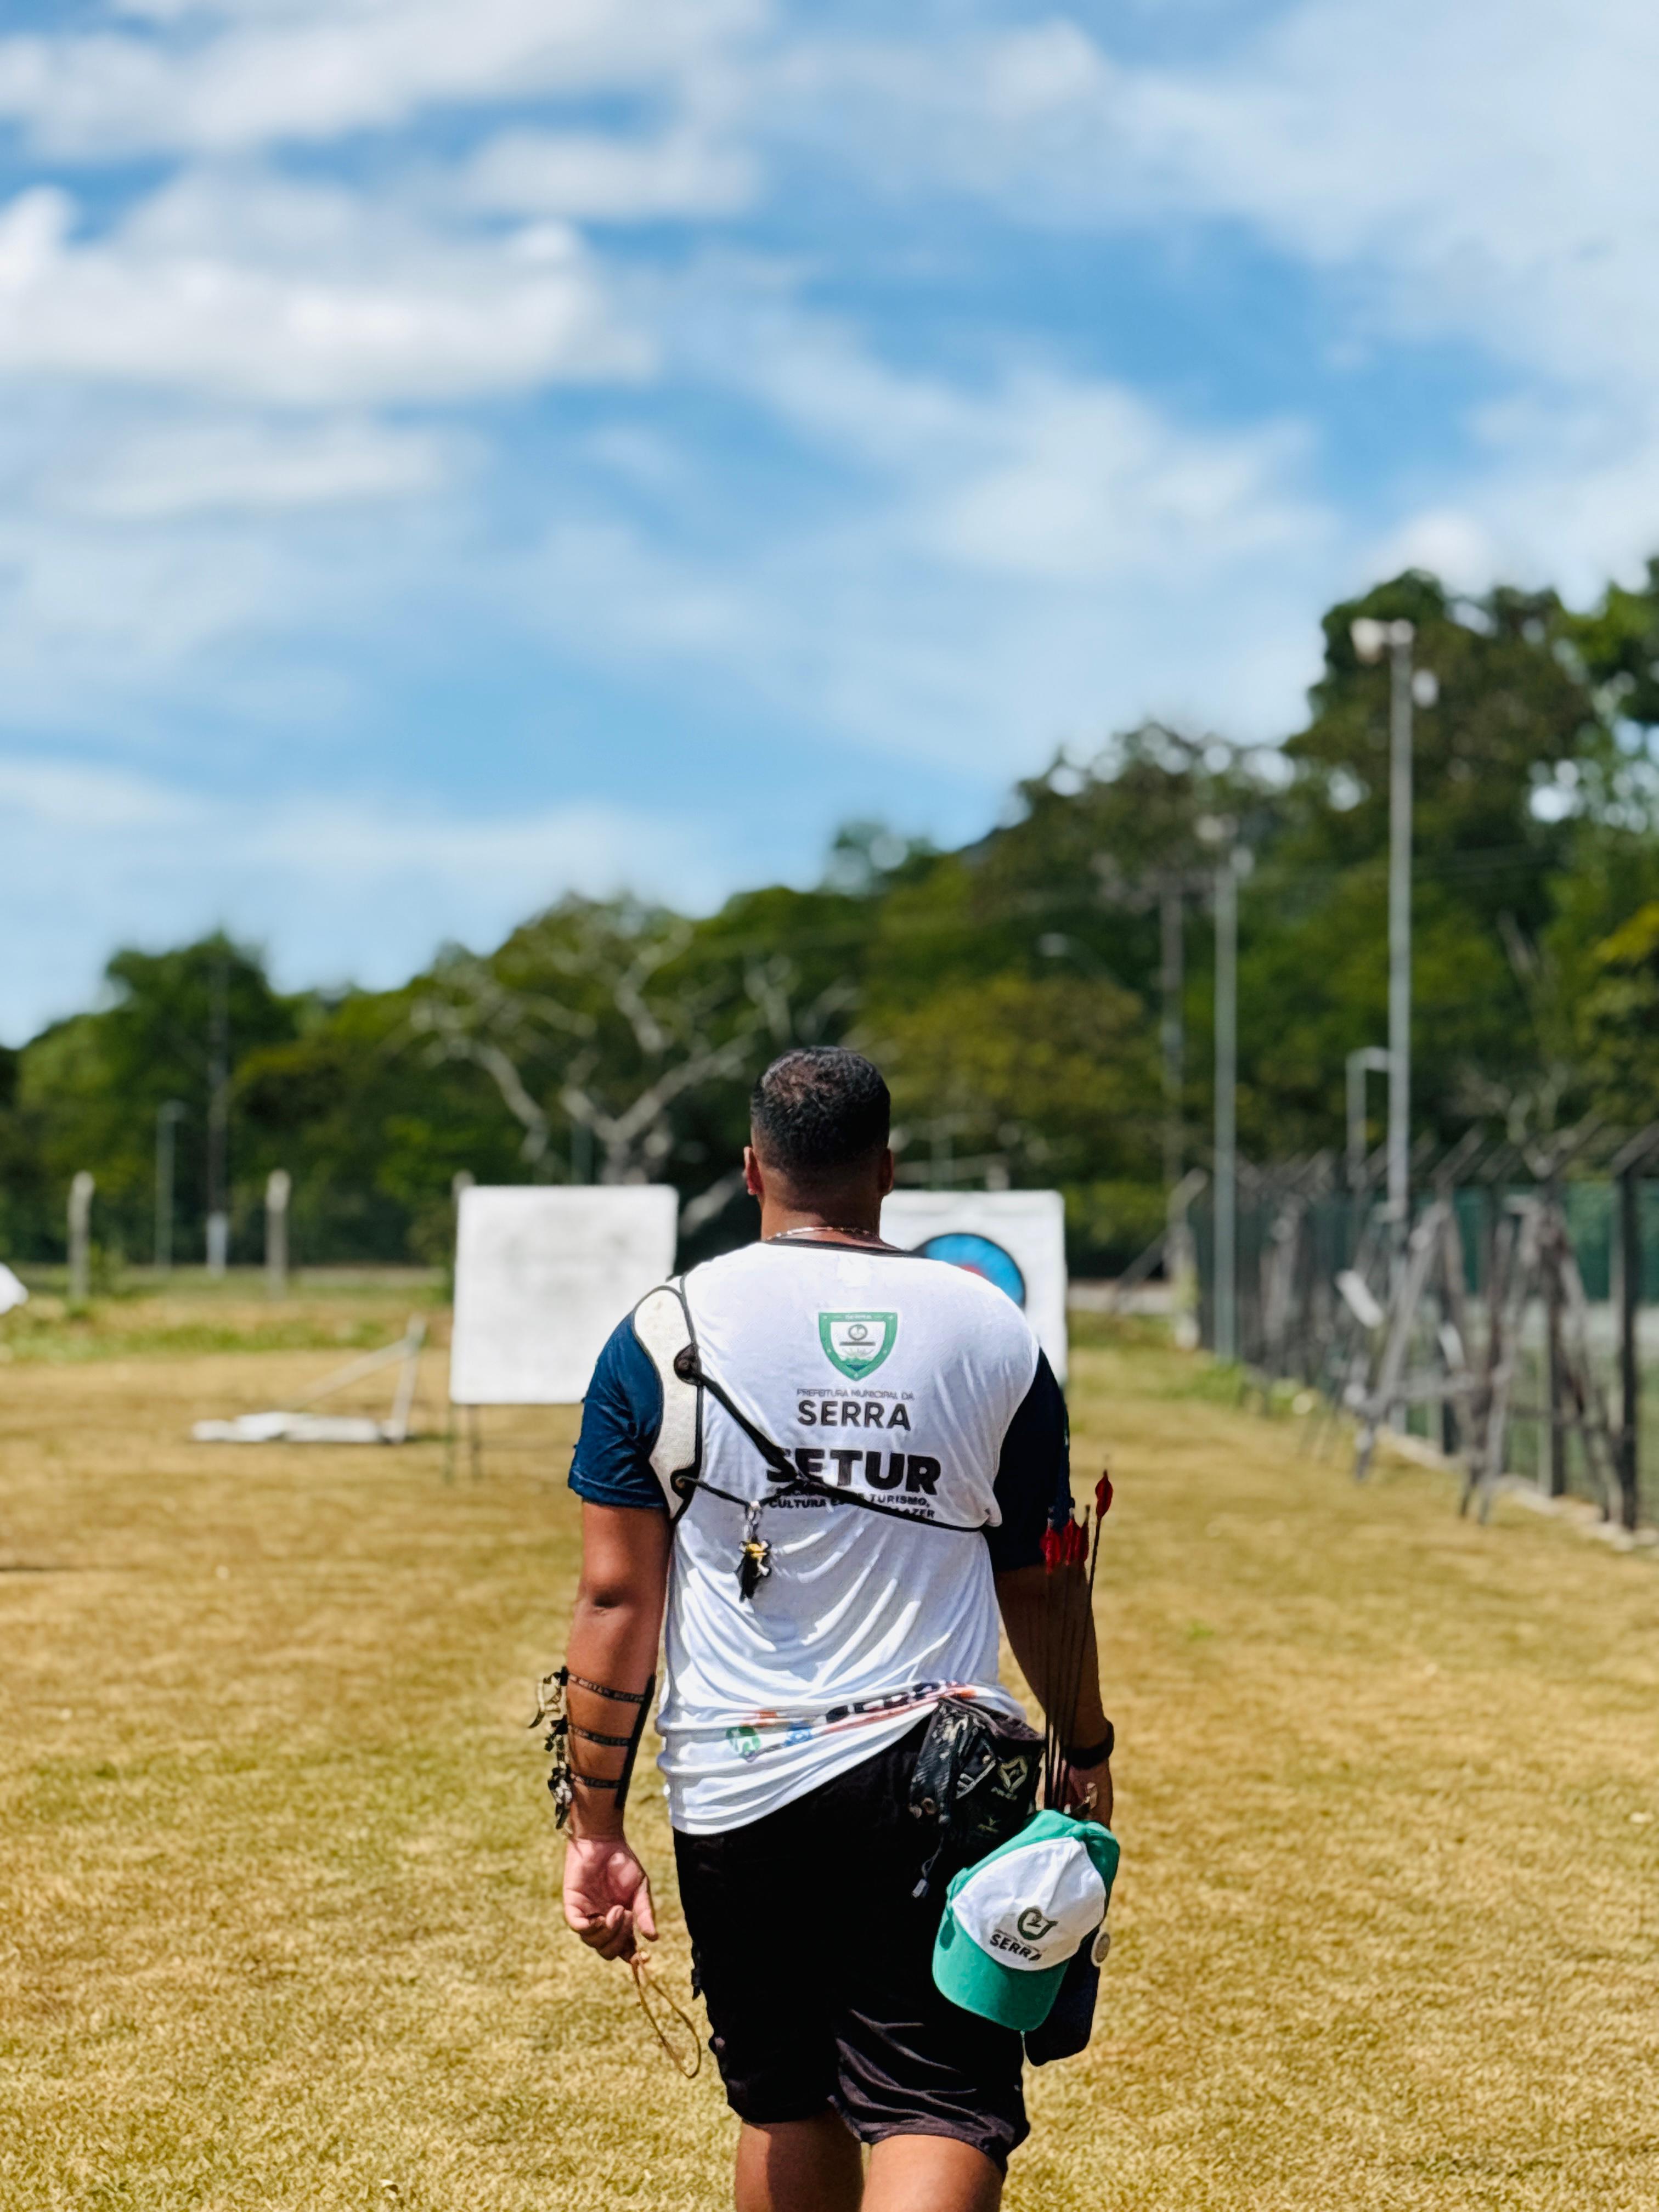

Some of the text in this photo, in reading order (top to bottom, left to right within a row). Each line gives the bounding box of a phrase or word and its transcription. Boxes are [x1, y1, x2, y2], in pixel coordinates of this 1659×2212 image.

[797, 1389, 849, 1397] PREFEITURA
[797, 1400, 911, 1431] SERRA
[870, 1493, 930, 1508] TURISMO,
